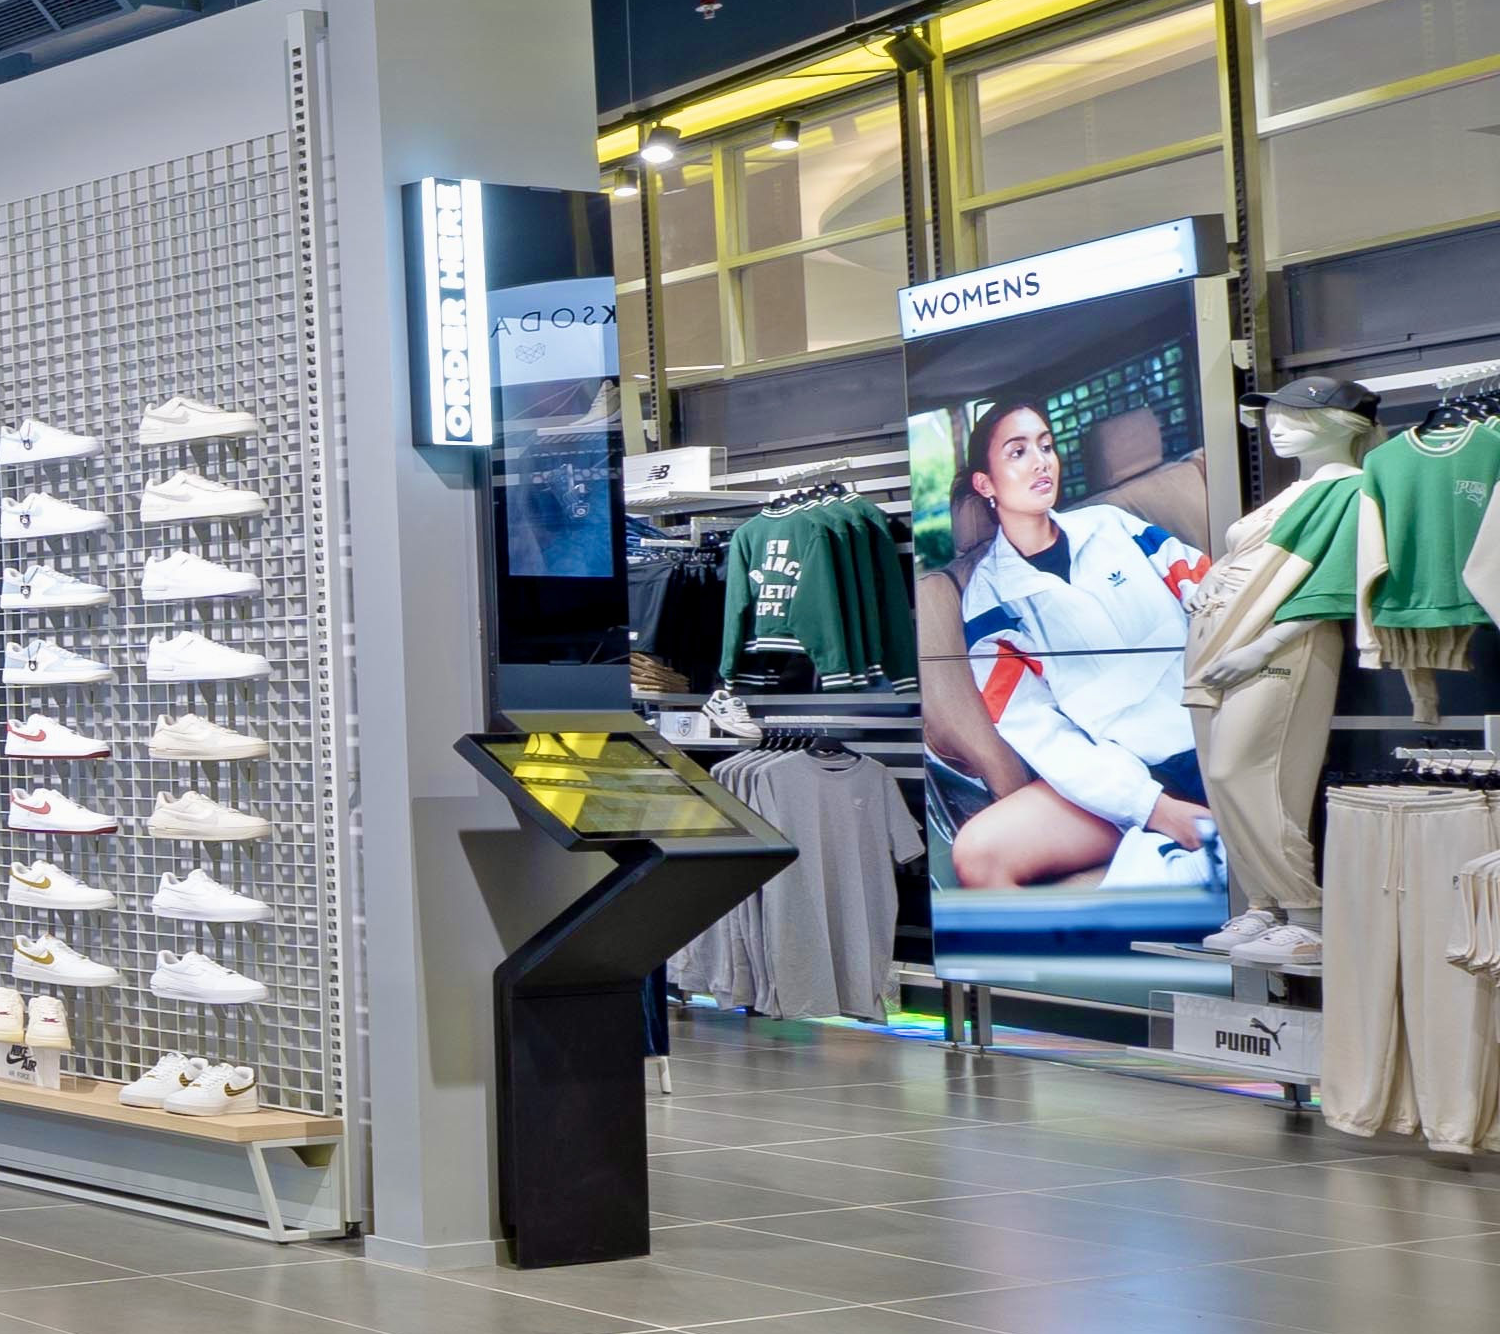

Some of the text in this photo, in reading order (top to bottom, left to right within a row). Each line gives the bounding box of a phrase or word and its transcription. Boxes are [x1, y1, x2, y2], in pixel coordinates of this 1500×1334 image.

[436, 184, 465, 290] HERE
[912, 271, 1041, 322] WOMENS
[441, 298, 472, 438] ORDER
[755, 601, 786, 617] EPT.
[1259, 665, 1291, 676] Puma
[1216, 1029, 1271, 1057] PUMA
[21, 1059, 37, 1072] AIR
